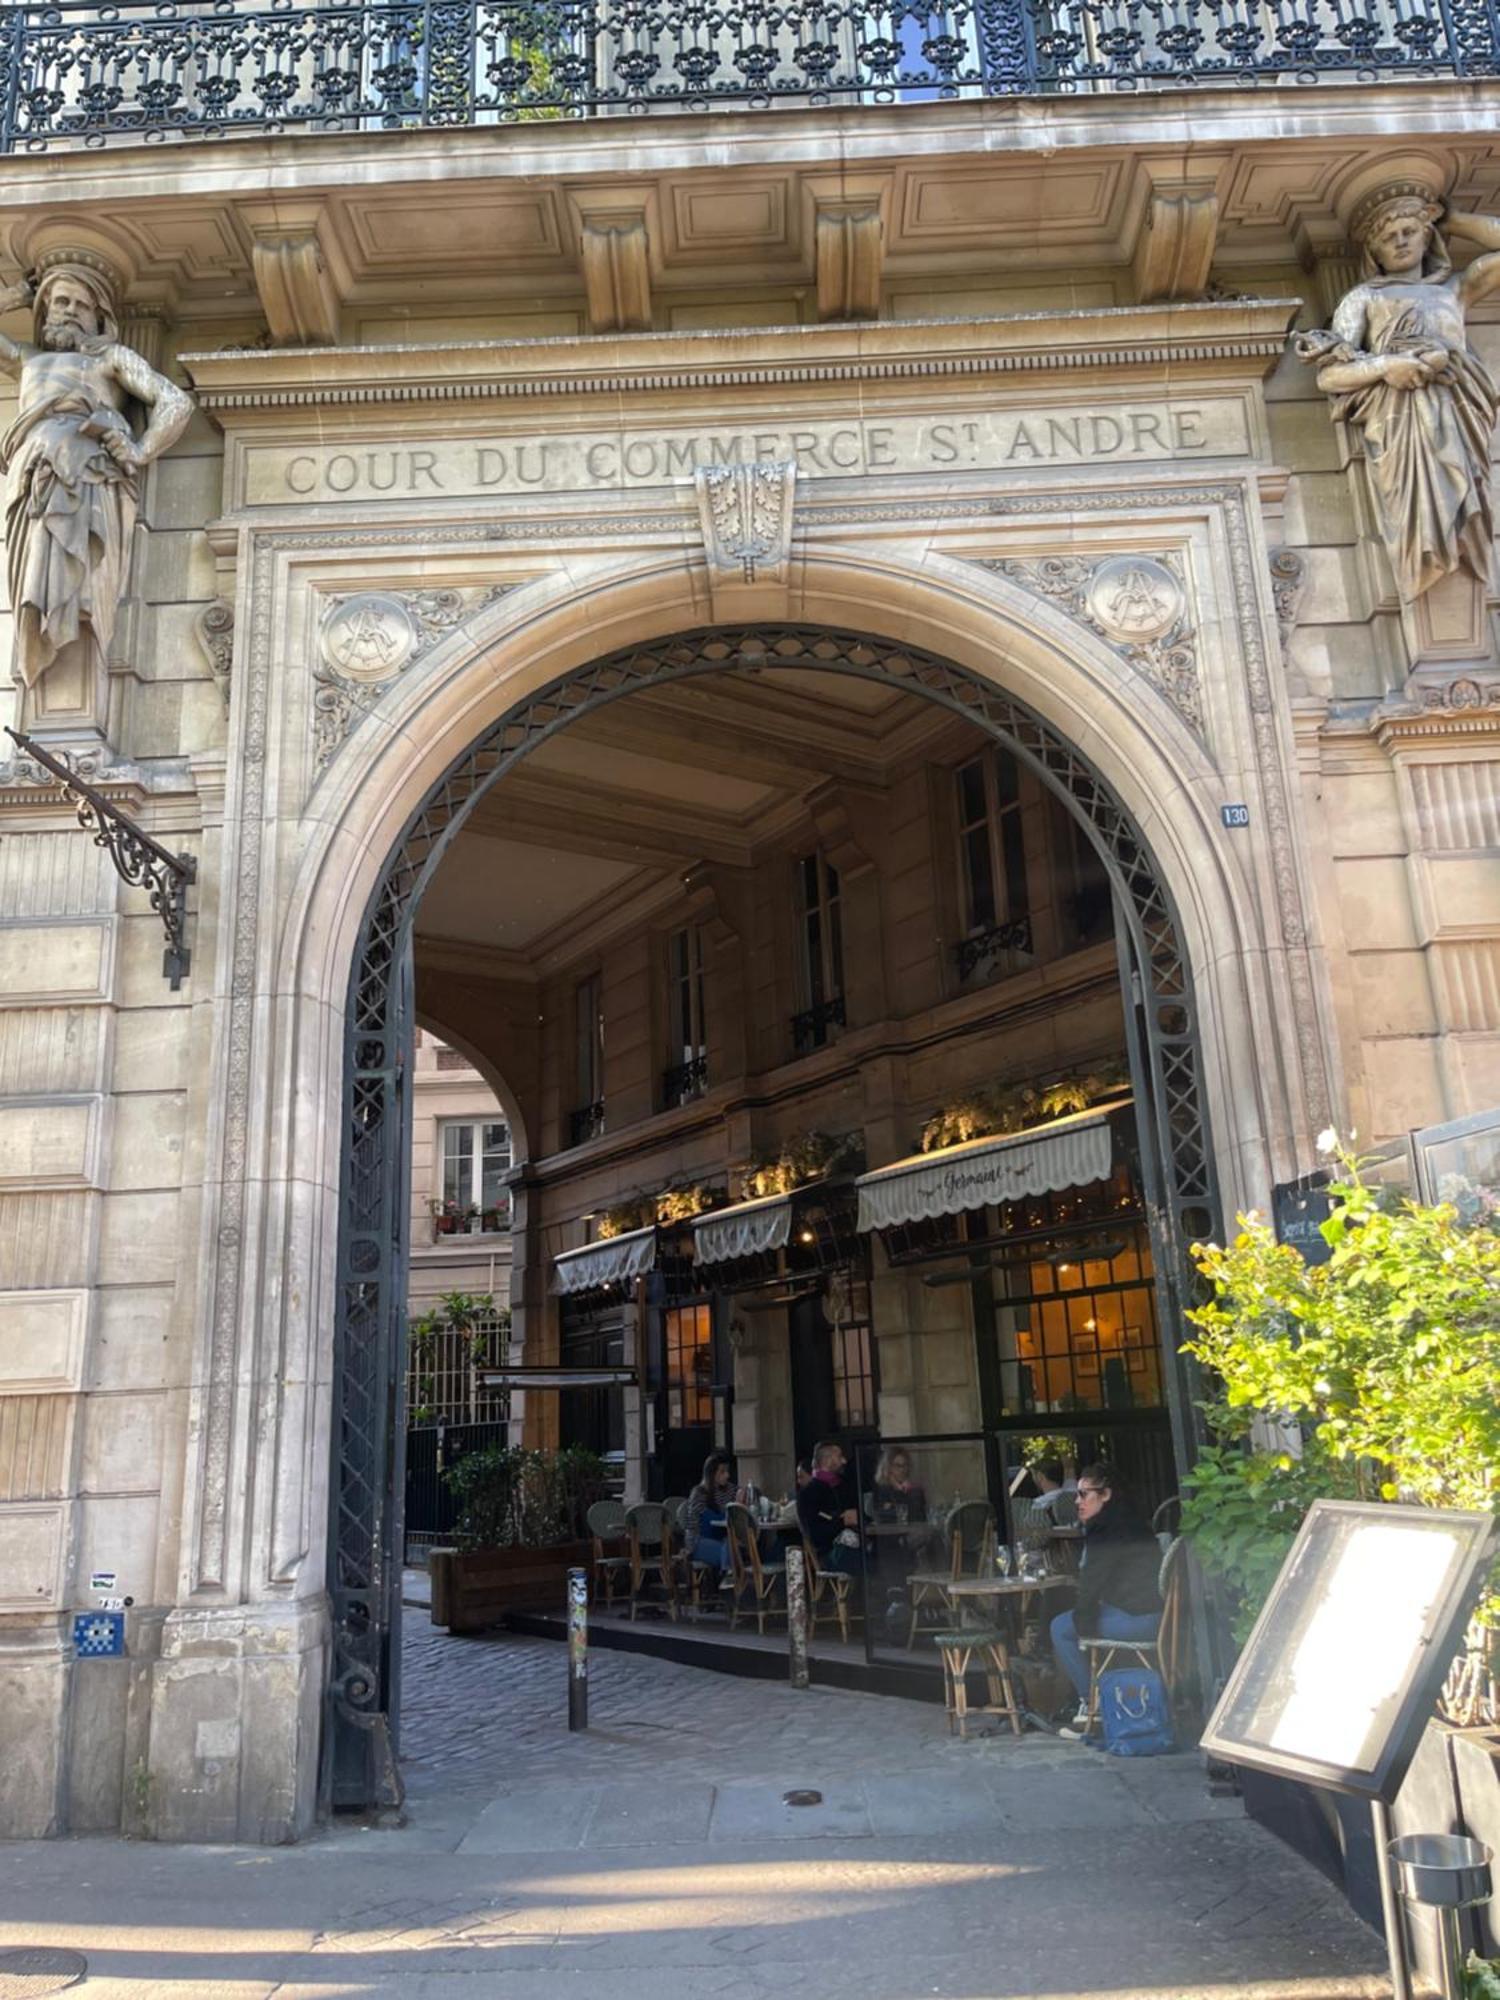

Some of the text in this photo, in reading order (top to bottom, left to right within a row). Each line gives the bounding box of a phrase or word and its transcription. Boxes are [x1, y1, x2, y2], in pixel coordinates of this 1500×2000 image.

[285, 449, 446, 495] COUR
[474, 445, 550, 486] DU
[585, 426, 897, 481] COMMERCE
[1006, 409, 1209, 461] ANDRE
[1223, 807, 1248, 825] 130
